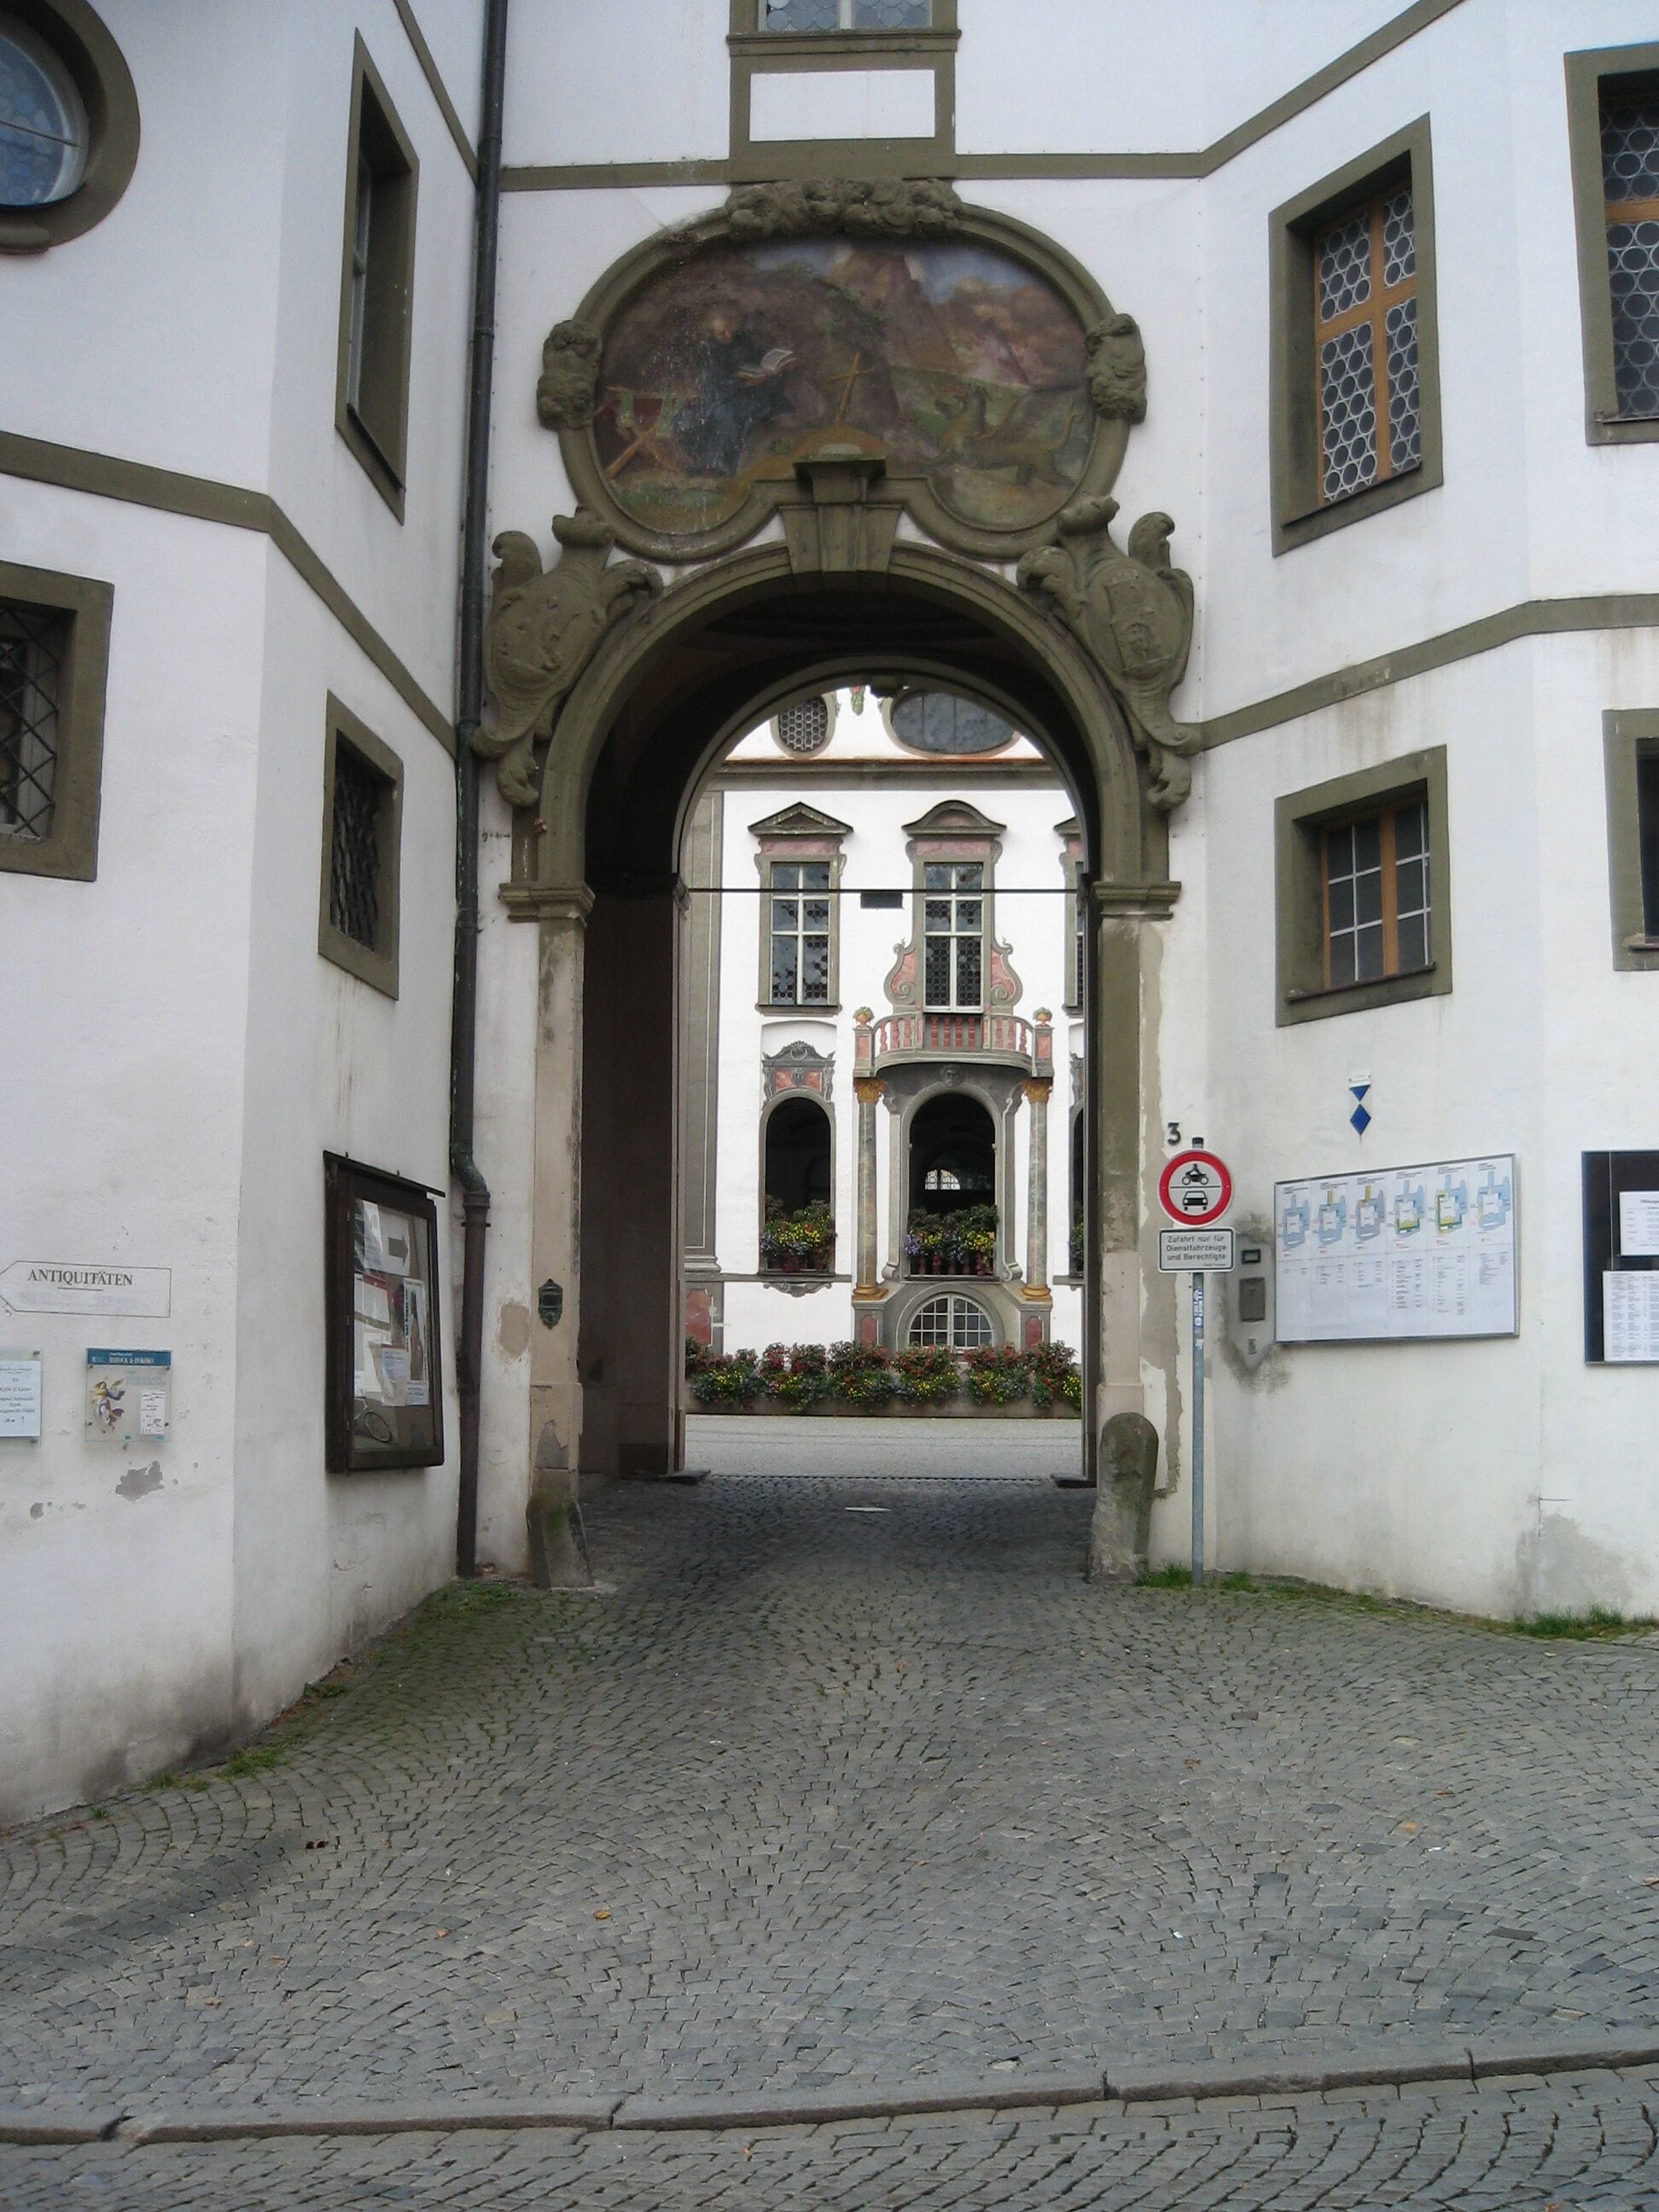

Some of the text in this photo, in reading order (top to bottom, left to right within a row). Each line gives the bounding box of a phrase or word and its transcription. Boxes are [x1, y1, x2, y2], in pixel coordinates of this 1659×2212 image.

[1167, 1122, 1181, 1145] 3
[1167, 1235, 1195, 1243] Zufahrt
[1166, 1244, 1227, 1253] Dienstfahrzeuge
[1183, 1253, 1226, 1261] Berechtigte
[27, 1268, 133, 1286] ANTIQUITÄTEN
